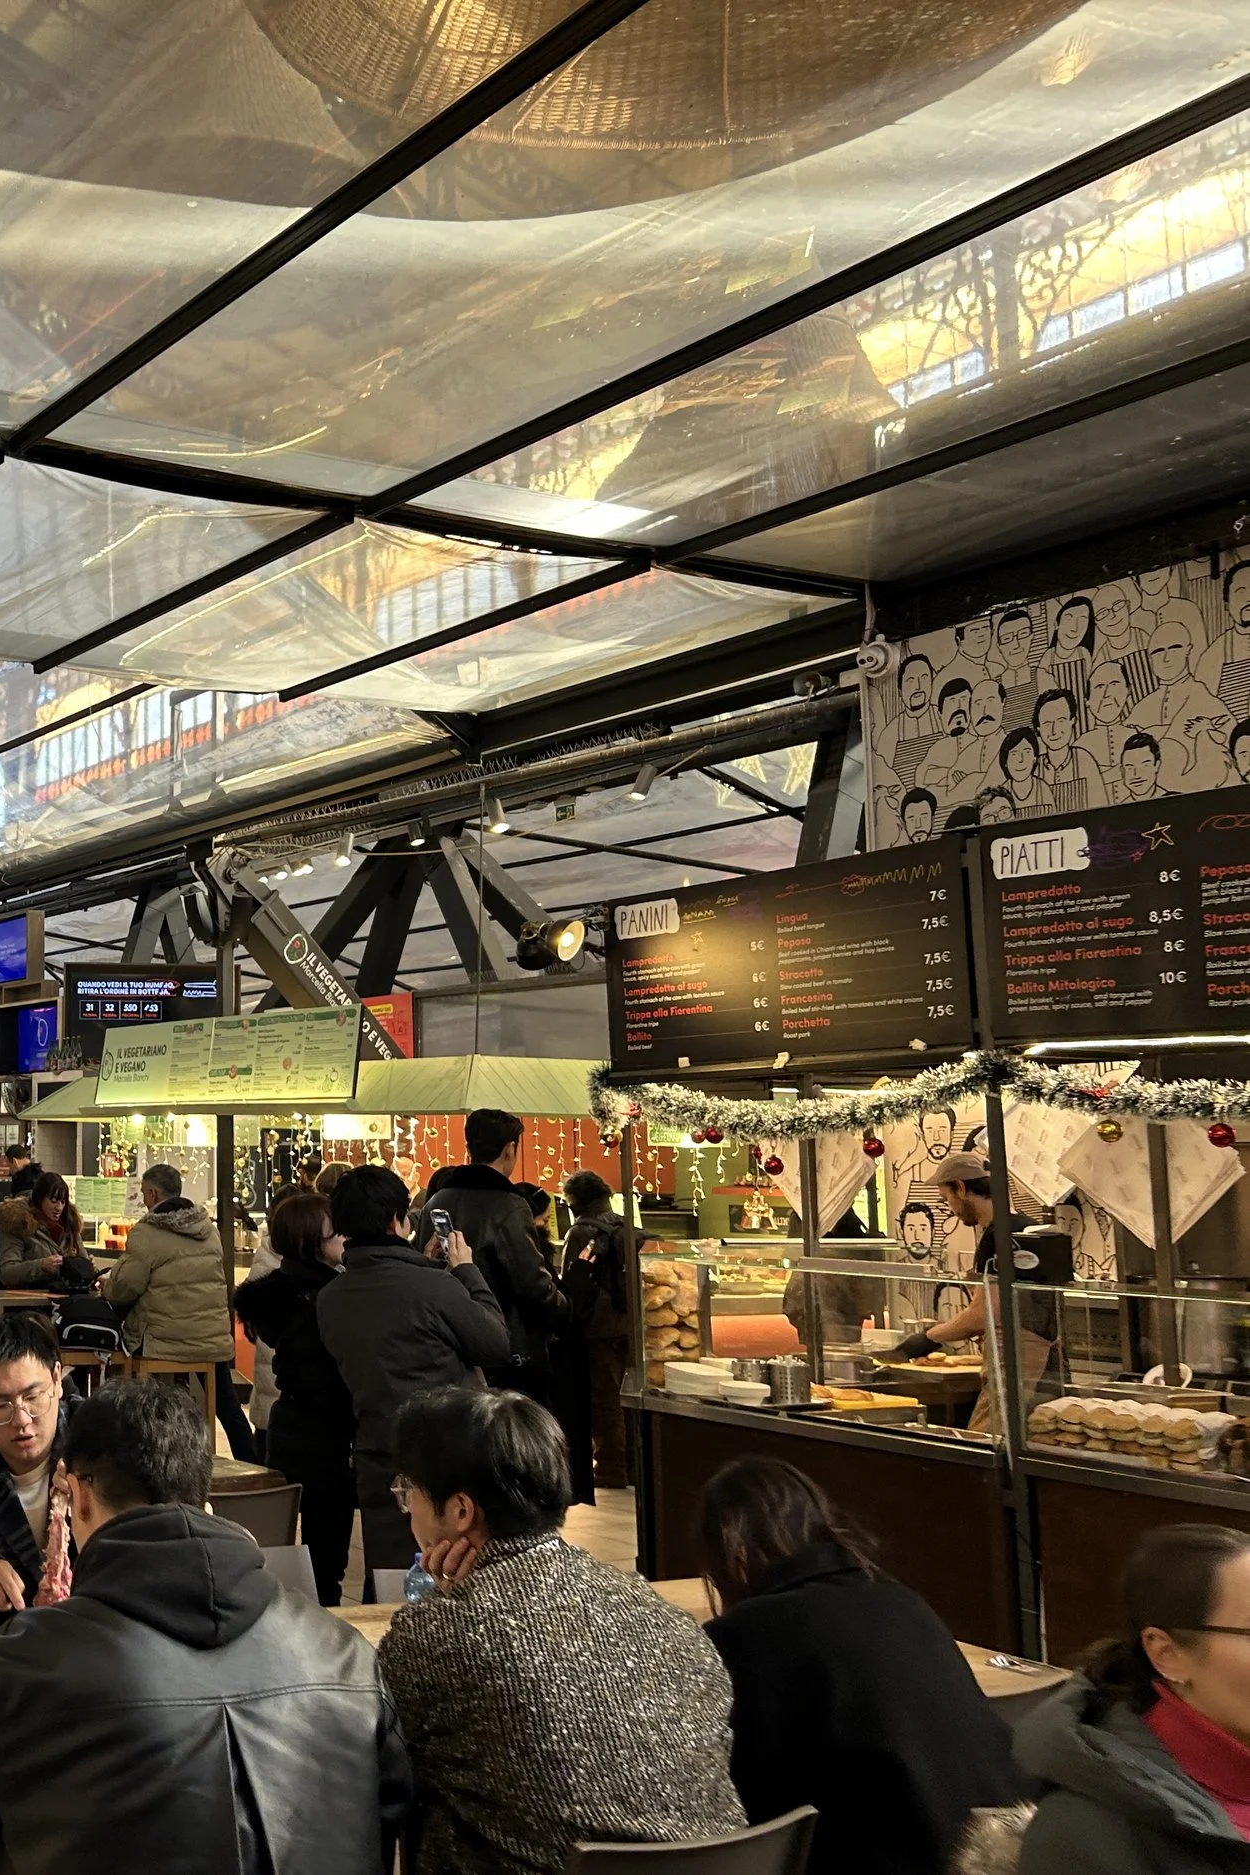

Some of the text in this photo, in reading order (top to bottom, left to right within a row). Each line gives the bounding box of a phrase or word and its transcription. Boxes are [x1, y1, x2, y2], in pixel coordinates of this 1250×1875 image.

[1000, 837, 1064, 874] PIATTI
[1159, 869, 1182, 882] 8€
[929, 889, 947, 902] 7€
[1001, 884, 1081, 902] Lampredotto
[620, 904, 669, 935] PANINI
[776, 914, 808, 924] Lingua
[921, 915, 949, 930] 7,5€
[1149, 908, 1185, 924] 8,5€
[1003, 916, 1135, 938] Lampredotto al sugo
[750, 940, 765, 952] 5€
[778, 938, 811, 949] Peposo
[1163, 940, 1186, 952] 8€
[622, 954, 675, 968] Lampredotto
[923, 951, 951, 965] 7,5€
[1004, 945, 1142, 967] Trippa alla Fiorentina
[752, 971, 767, 982] 6€
[779, 968, 824, 980] Stracotto
[1158, 971, 1187, 984] 10€
[624, 981, 708, 996] Lampredotto al sugo
[926, 978, 953, 992] 7,5€
[1006, 977, 1116, 994] Bollito Mitologico
[306, 952, 317, 967] IL
[368, 1030, 378, 1042] E
[374, 1037, 397, 1060] VEG
[753, 997, 769, 1008] 6€
[625, 1004, 713, 1022] Trippa alla Fiorentina
[927, 1004, 954, 1018] 7,5€
[754, 1020, 770, 1032] 6€
[782, 1018, 831, 1030] Porchetta
[627, 1032, 652, 1042] Bollito
[117, 1044, 167, 1058] IL VEGETARIANO
[115, 1061, 146, 1073] E VEGANO
